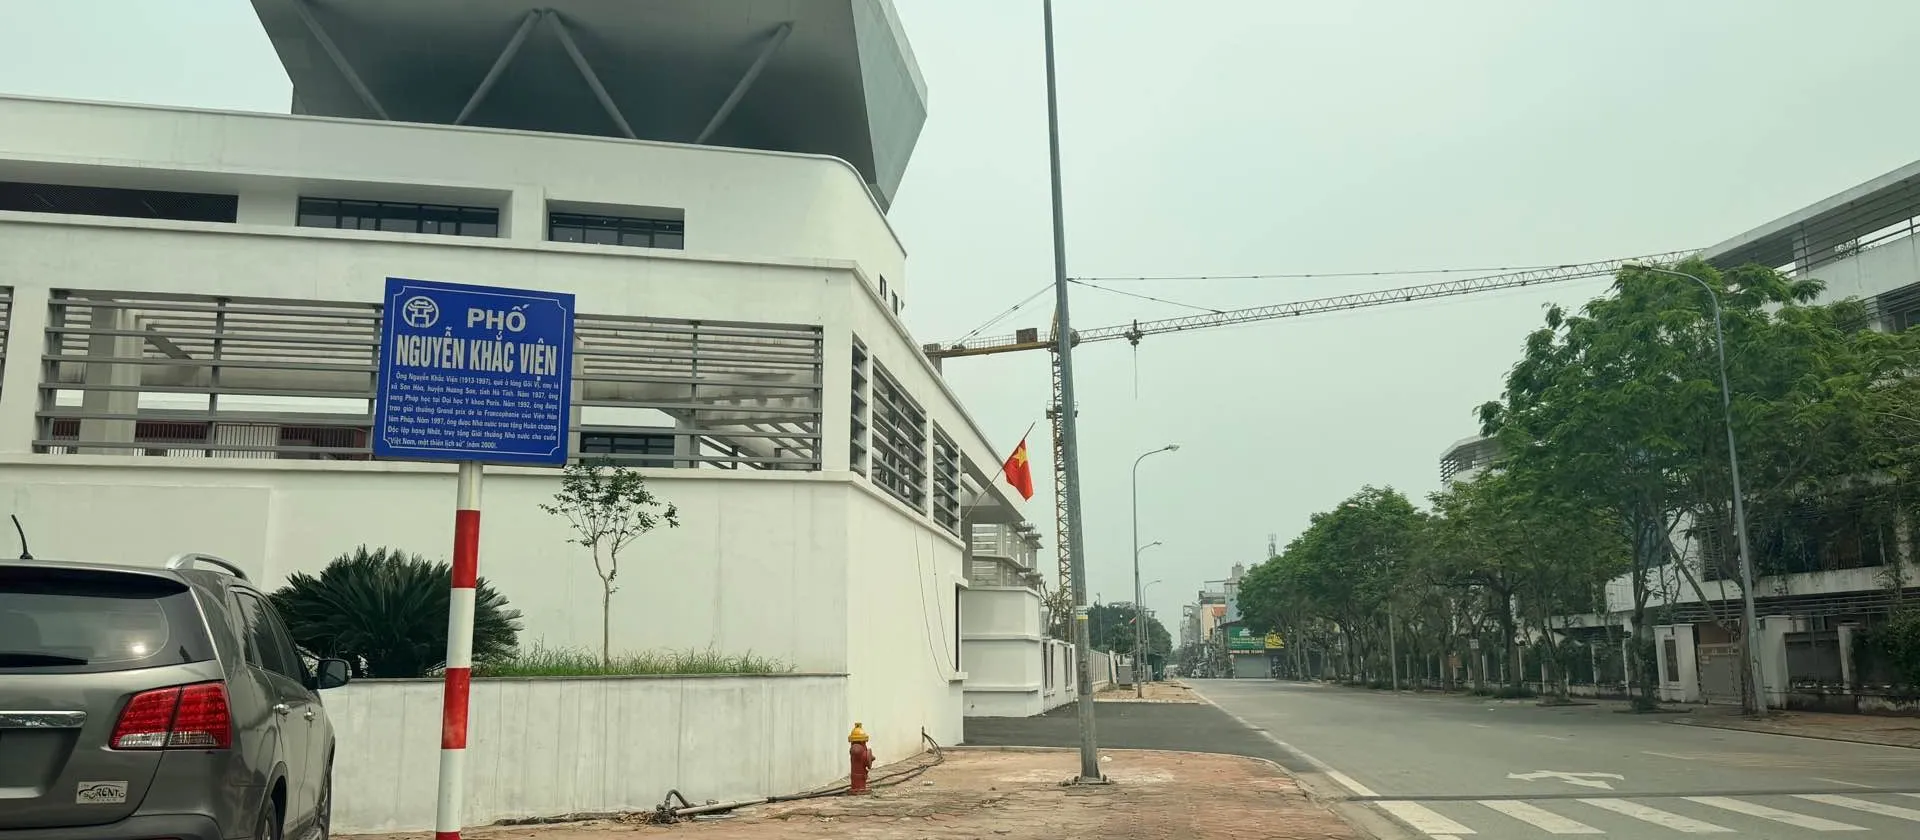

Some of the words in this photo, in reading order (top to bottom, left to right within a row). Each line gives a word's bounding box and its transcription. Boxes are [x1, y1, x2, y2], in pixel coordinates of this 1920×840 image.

[468, 304, 530, 332] PHỐ
[396, 327, 465, 370] NGUYỄN
[470, 332, 514, 373] KHẮC
[520, 338, 557, 381] VIỆN
[396, 371, 407, 380] Ông
[409, 373, 429, 381] Nguyễn
[446, 376, 458, 384] Viện
[428, 385, 443, 393] huyện
